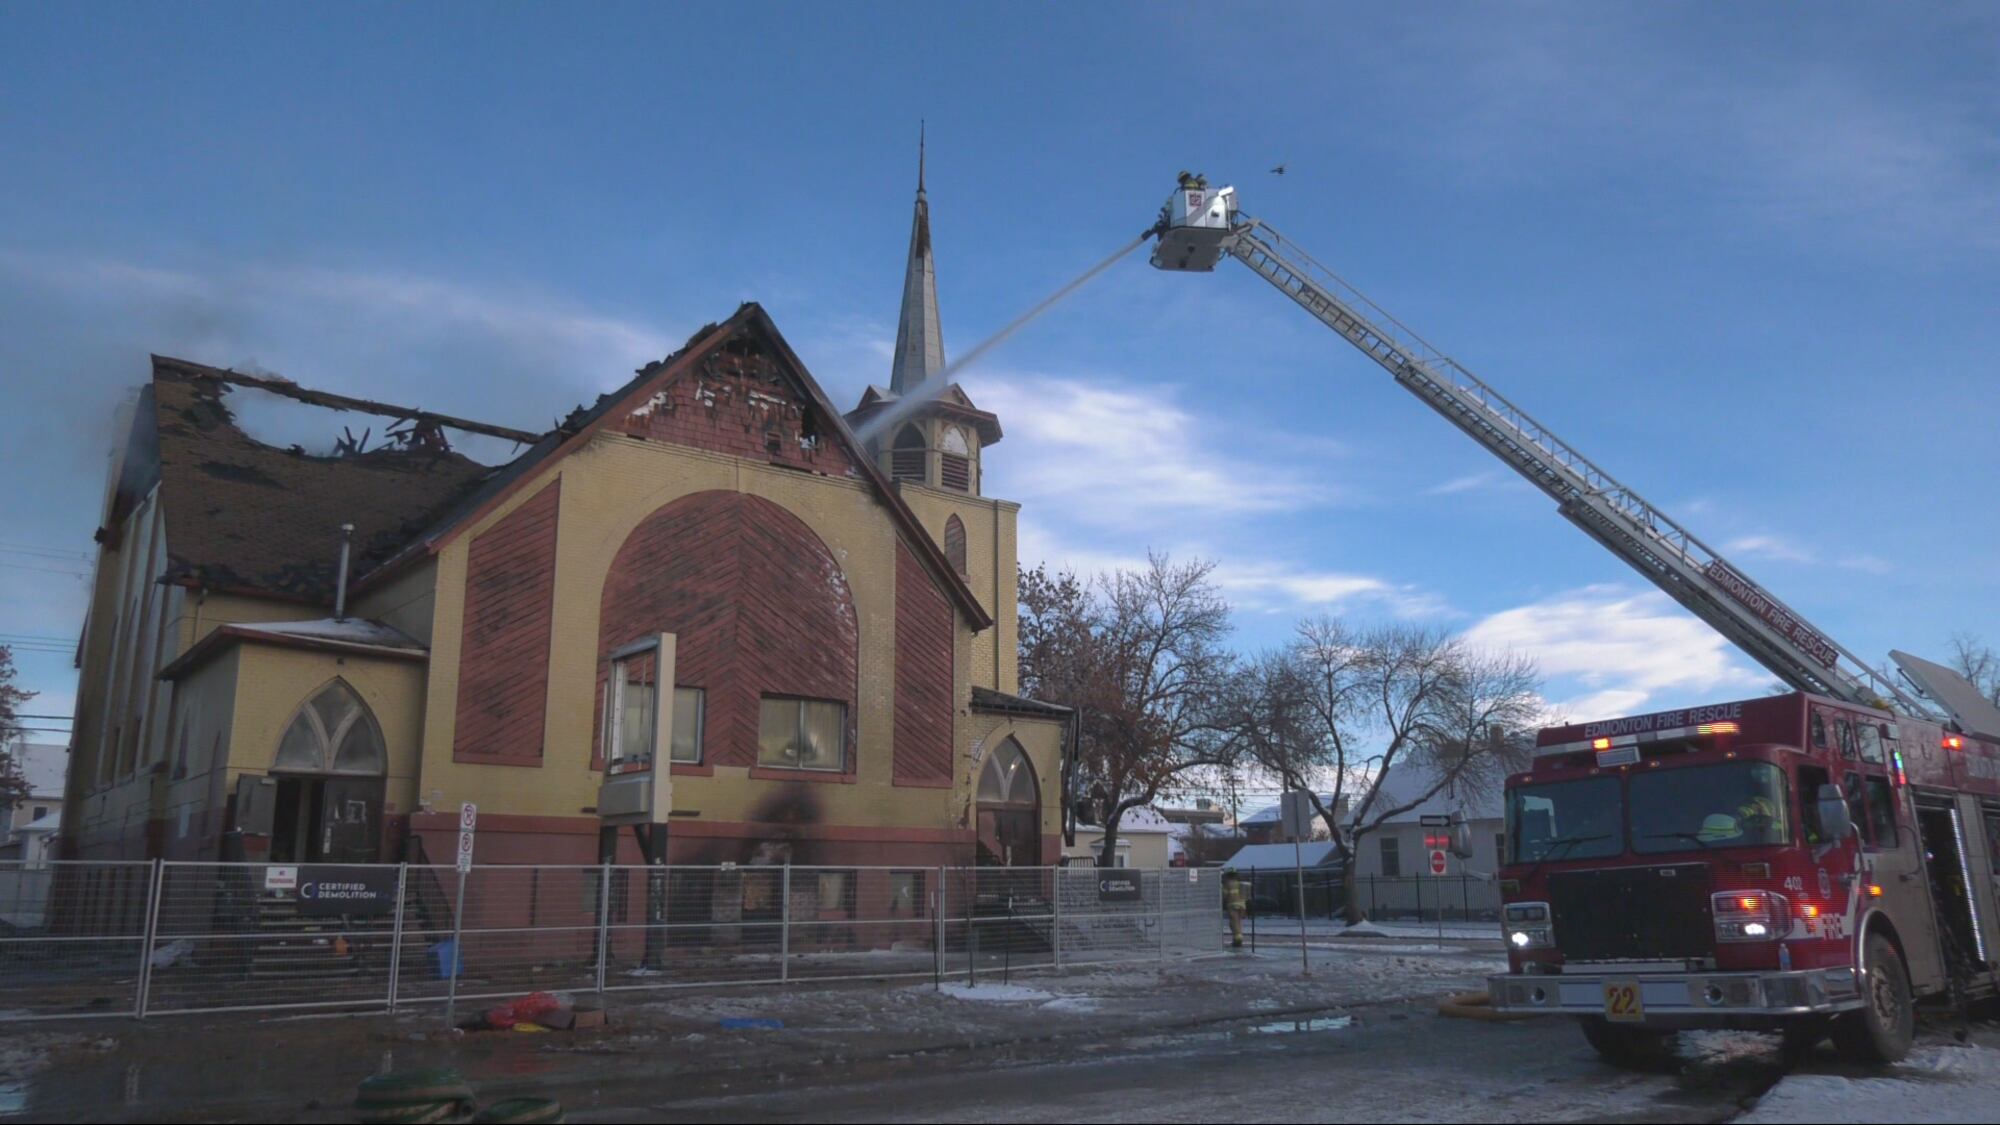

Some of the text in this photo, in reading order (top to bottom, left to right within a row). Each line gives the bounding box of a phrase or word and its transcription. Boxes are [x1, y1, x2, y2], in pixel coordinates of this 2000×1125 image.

[1708, 564, 1836, 664] EDMONTON FIRE RESCUE
[1585, 703, 1742, 738] EDMONTON FIRE RESCUE
[318, 891, 377, 899] DEMOLITION
[319, 882, 366, 891] CERTIFIED
[1820, 912, 1844, 940] FIRE
[1608, 986, 1637, 1014] 22
